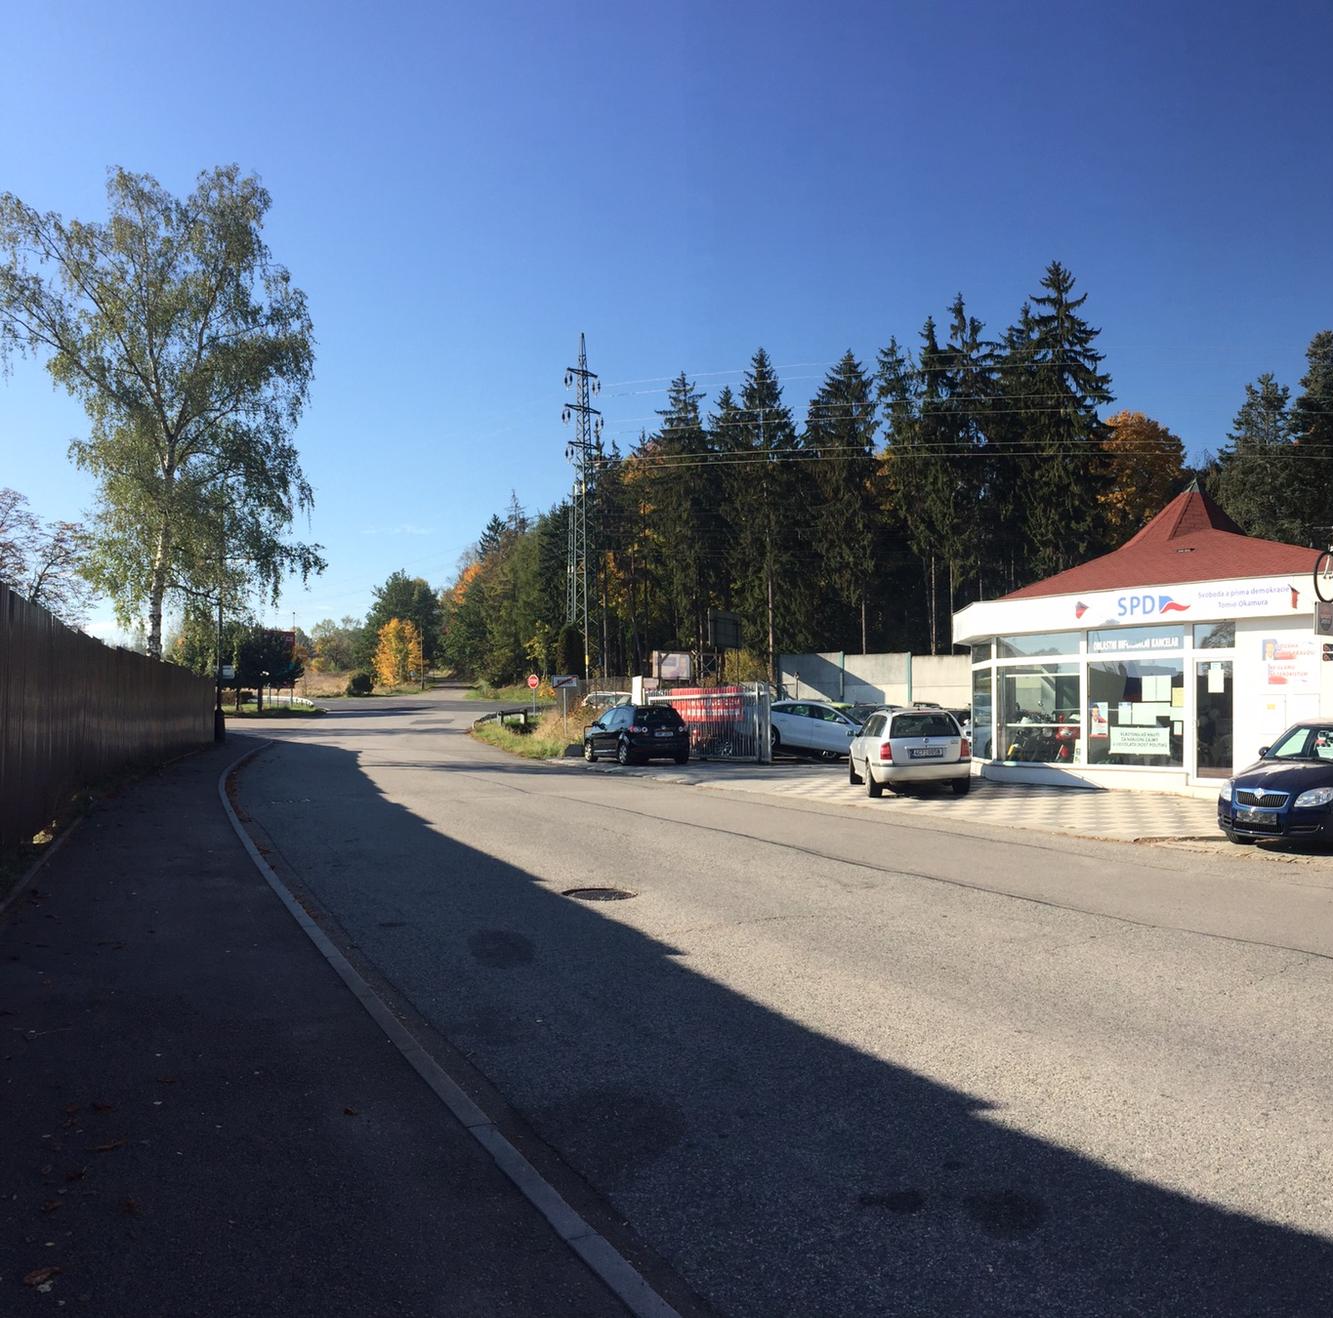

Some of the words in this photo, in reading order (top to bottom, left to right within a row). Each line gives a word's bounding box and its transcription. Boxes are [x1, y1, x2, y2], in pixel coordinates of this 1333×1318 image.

[1250, 585, 1290, 595] demokracie
[1117, 595, 1156, 617] SPD
[1238, 598, 1269, 609] Okamura
